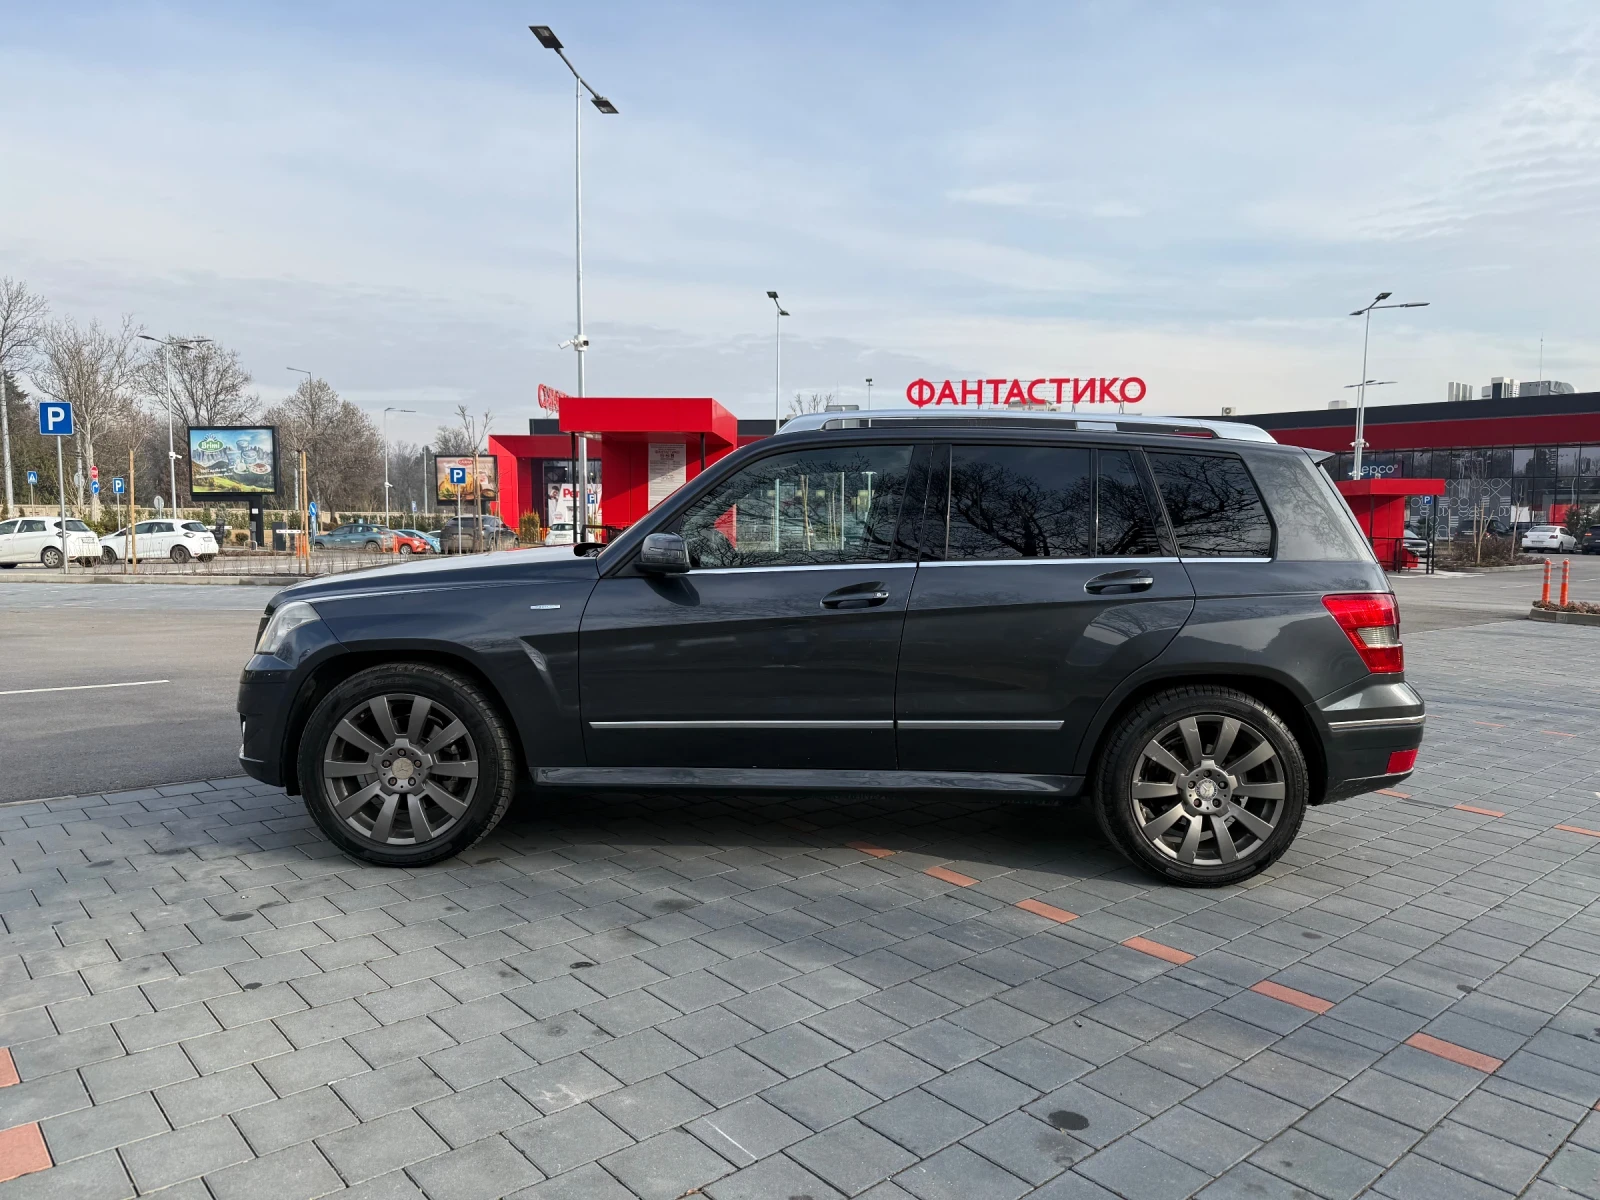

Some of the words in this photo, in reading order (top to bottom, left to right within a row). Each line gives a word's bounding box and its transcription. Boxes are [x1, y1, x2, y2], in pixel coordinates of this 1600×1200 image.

[906, 377, 1146, 408] ФАНТАСТИКО
[48, 407, 65, 430] P
[453, 470, 463, 482] P
[1360, 465, 1395, 476] epco
[115, 481, 122, 491] P
